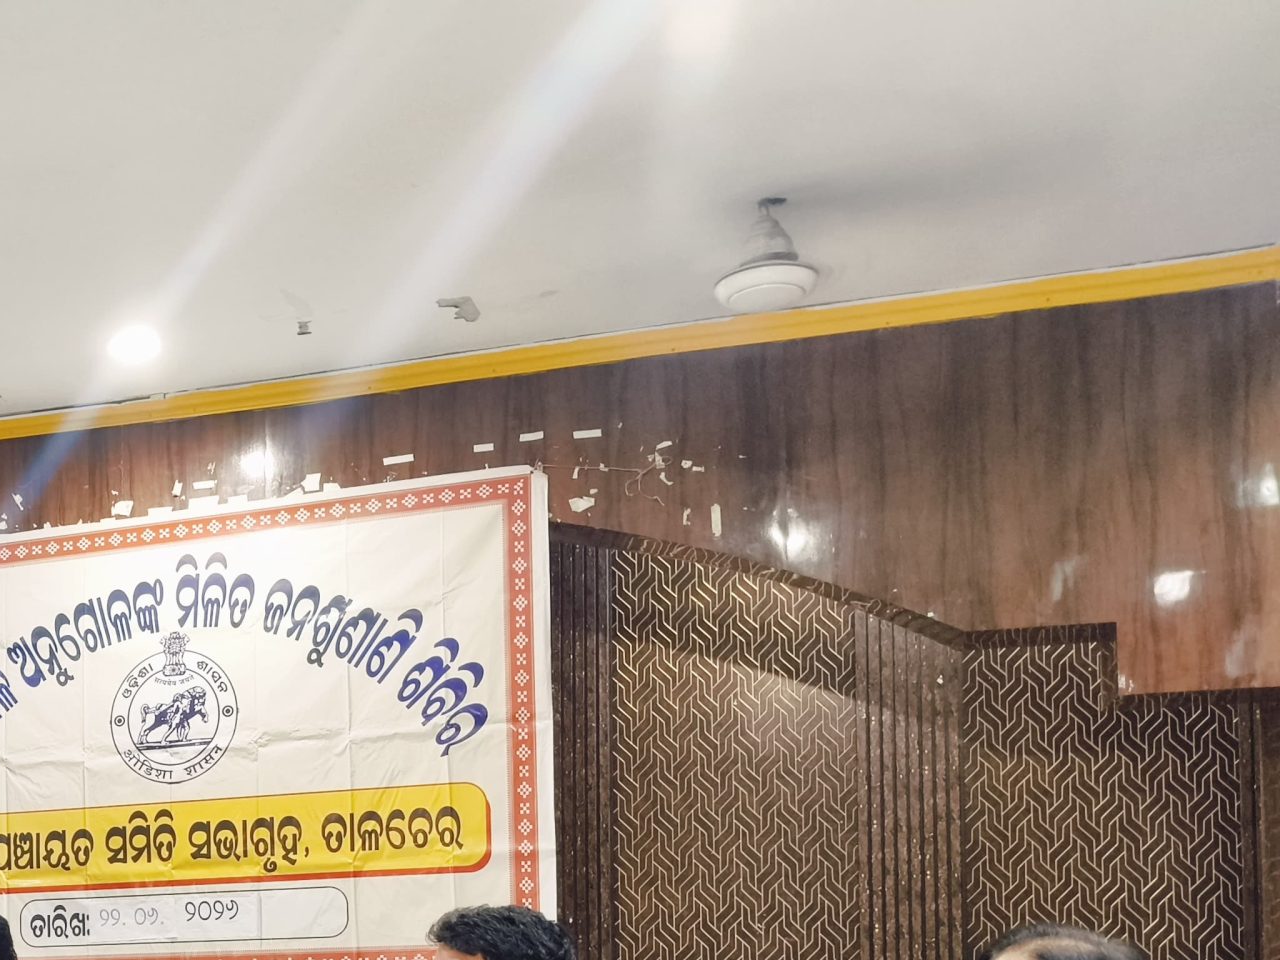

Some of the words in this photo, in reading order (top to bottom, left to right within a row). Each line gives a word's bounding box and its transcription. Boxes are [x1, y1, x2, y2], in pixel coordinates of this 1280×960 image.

[175, 551, 255, 629] ମିଳିତ
[397, 637, 489, 757] ଶିବିର
[184, 743, 223, 777] शासन
[105, 808, 177, 865] ସମିତି
[188, 814, 310, 873] ସଭାଗୃହ,
[321, 805, 464, 855] ତାଳଚେର
